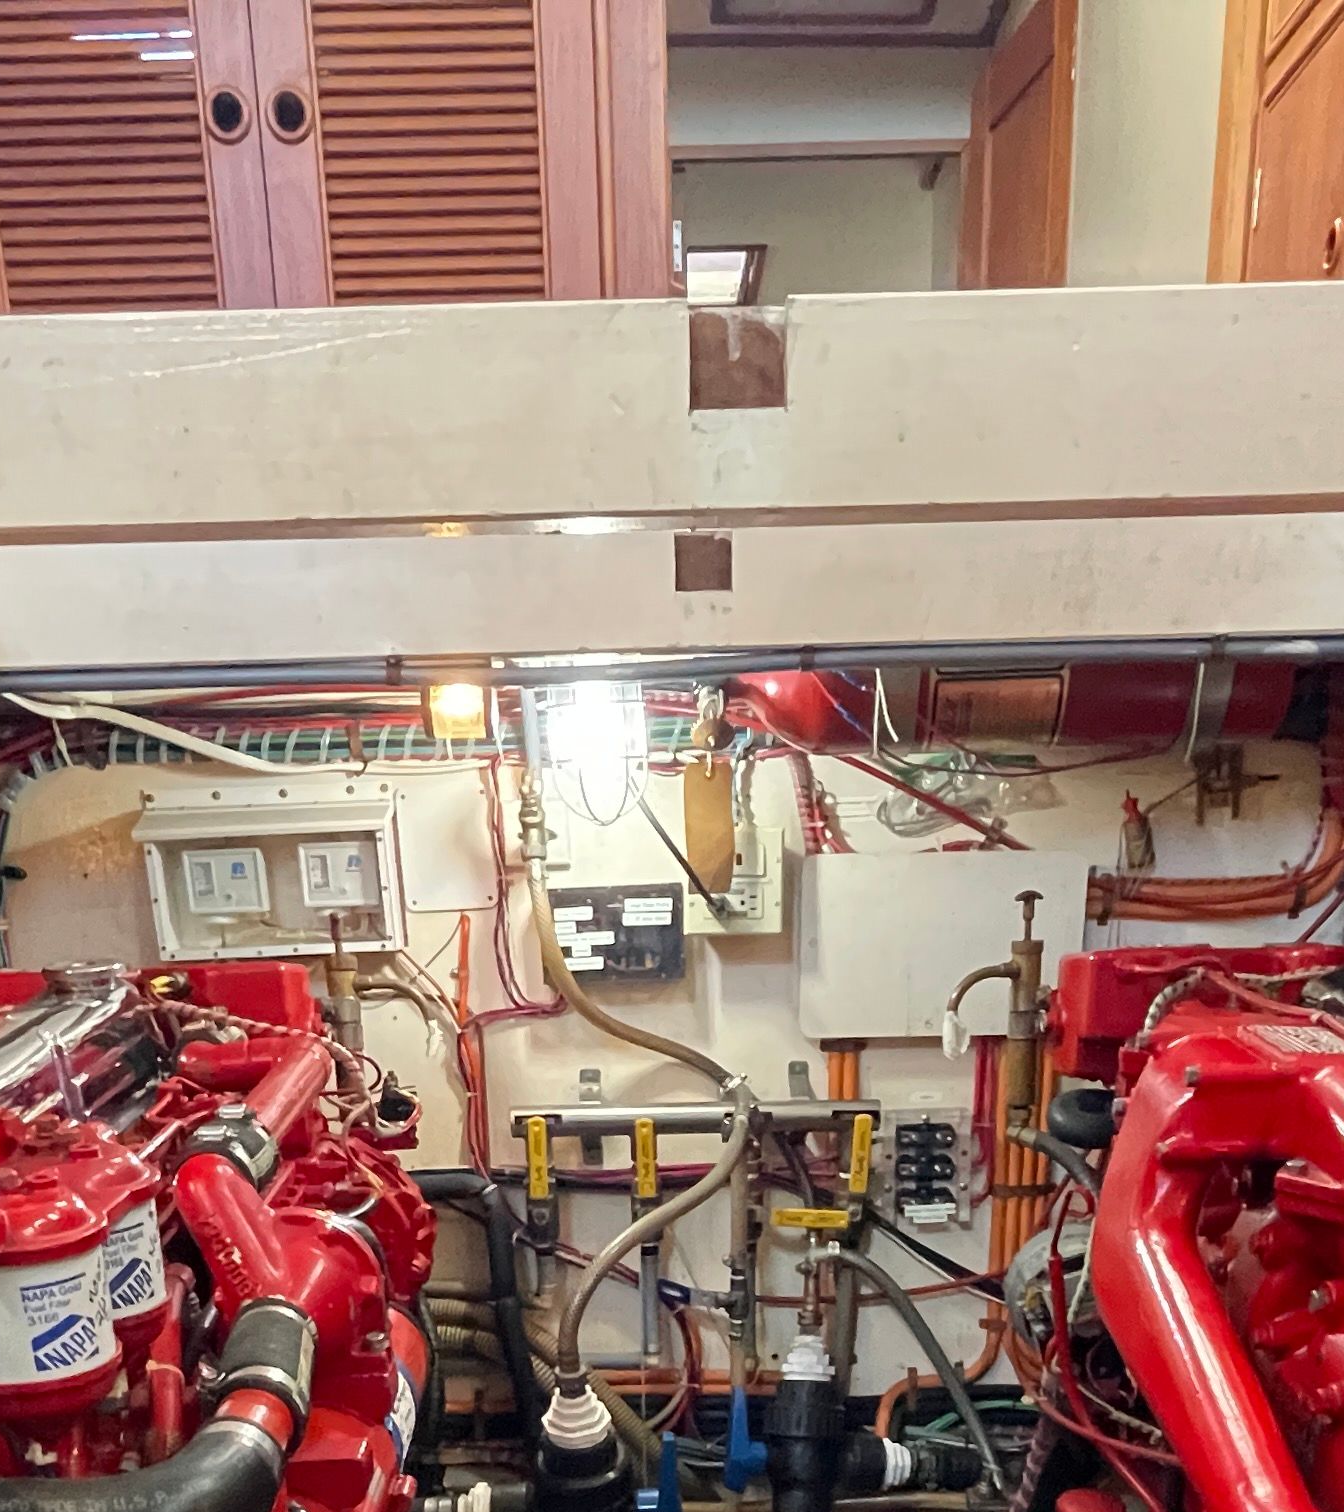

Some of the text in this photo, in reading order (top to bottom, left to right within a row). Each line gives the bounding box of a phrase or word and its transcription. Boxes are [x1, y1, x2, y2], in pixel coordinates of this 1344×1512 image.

[21, 1281, 82, 1303] NAPA Gold
[116, 1267, 153, 1308] NAPA
[42, 1323, 98, 1369] NAPA
